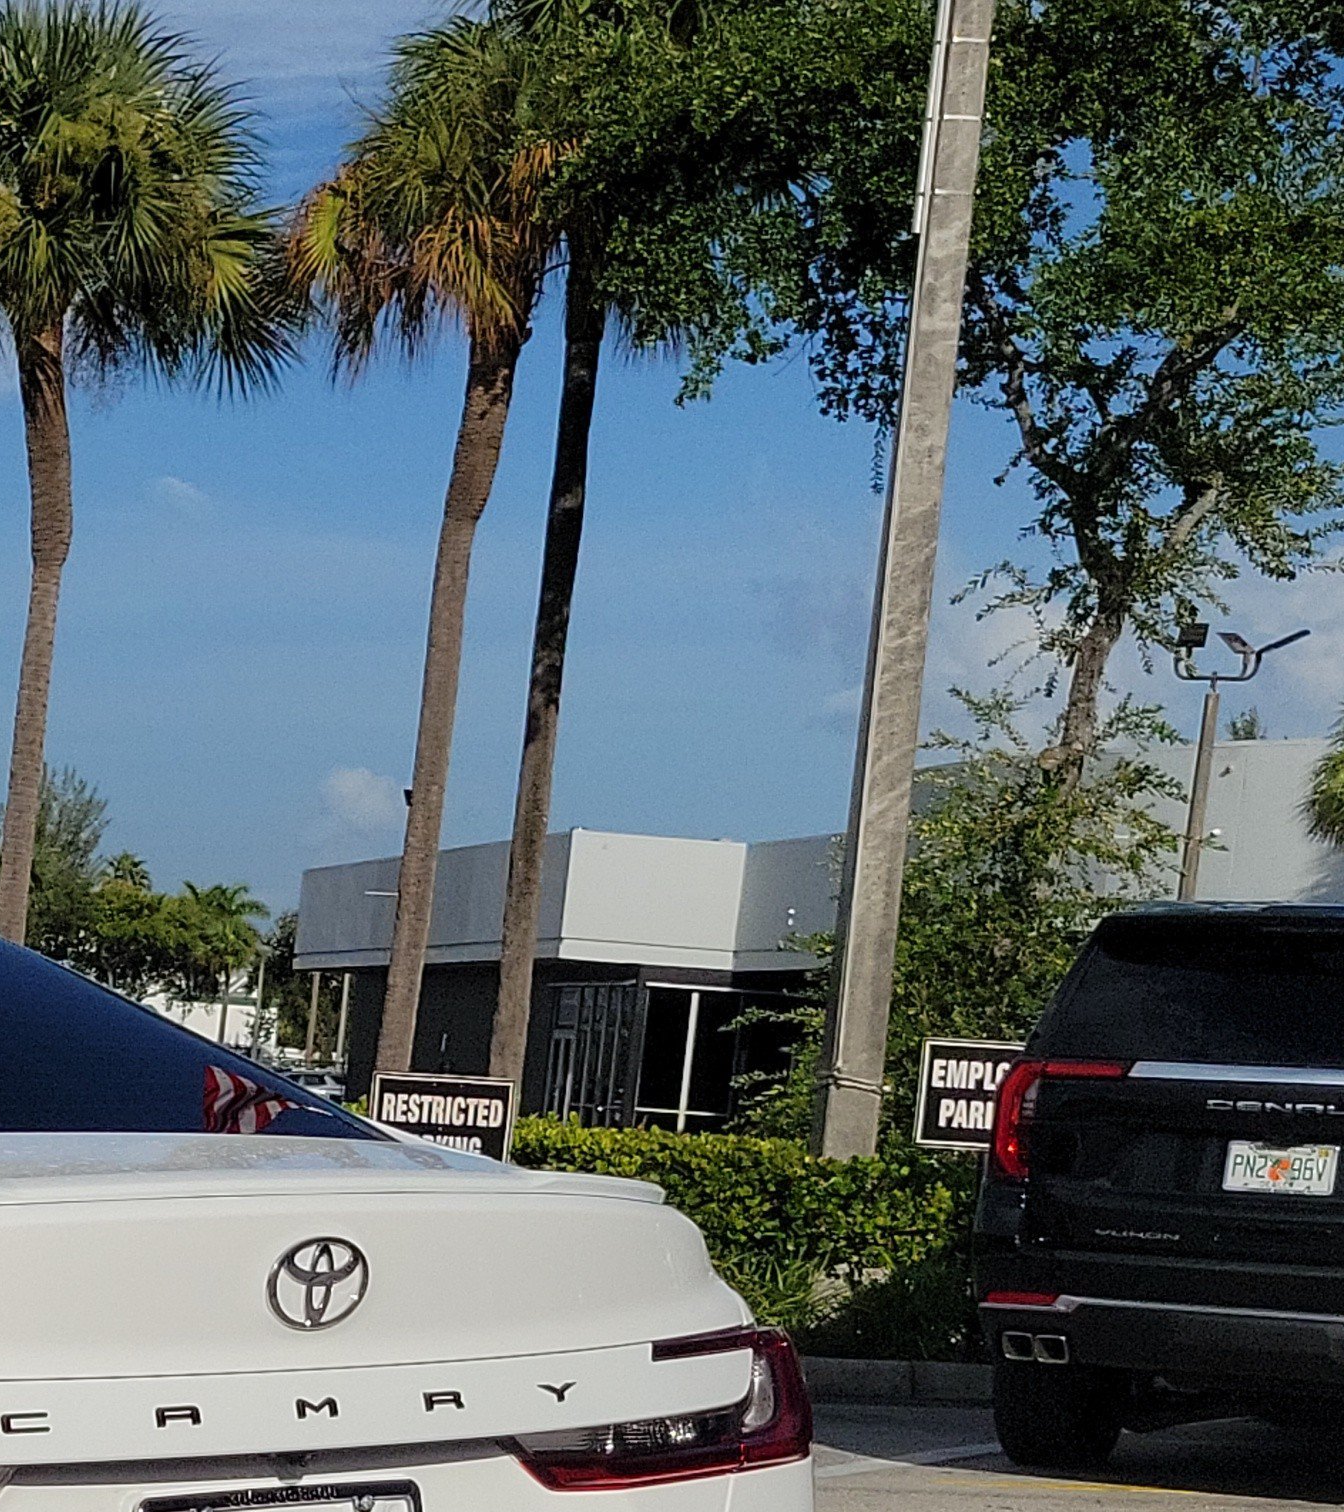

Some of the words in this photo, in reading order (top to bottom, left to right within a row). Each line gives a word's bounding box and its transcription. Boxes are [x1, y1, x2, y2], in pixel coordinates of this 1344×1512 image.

[930, 1059, 1012, 1091] EMPLO
[380, 1092, 505, 1128] RESTRICTED
[1205, 1099, 1344, 1116] DENAL
[0, 1381, 578, 1435] CAMRY
